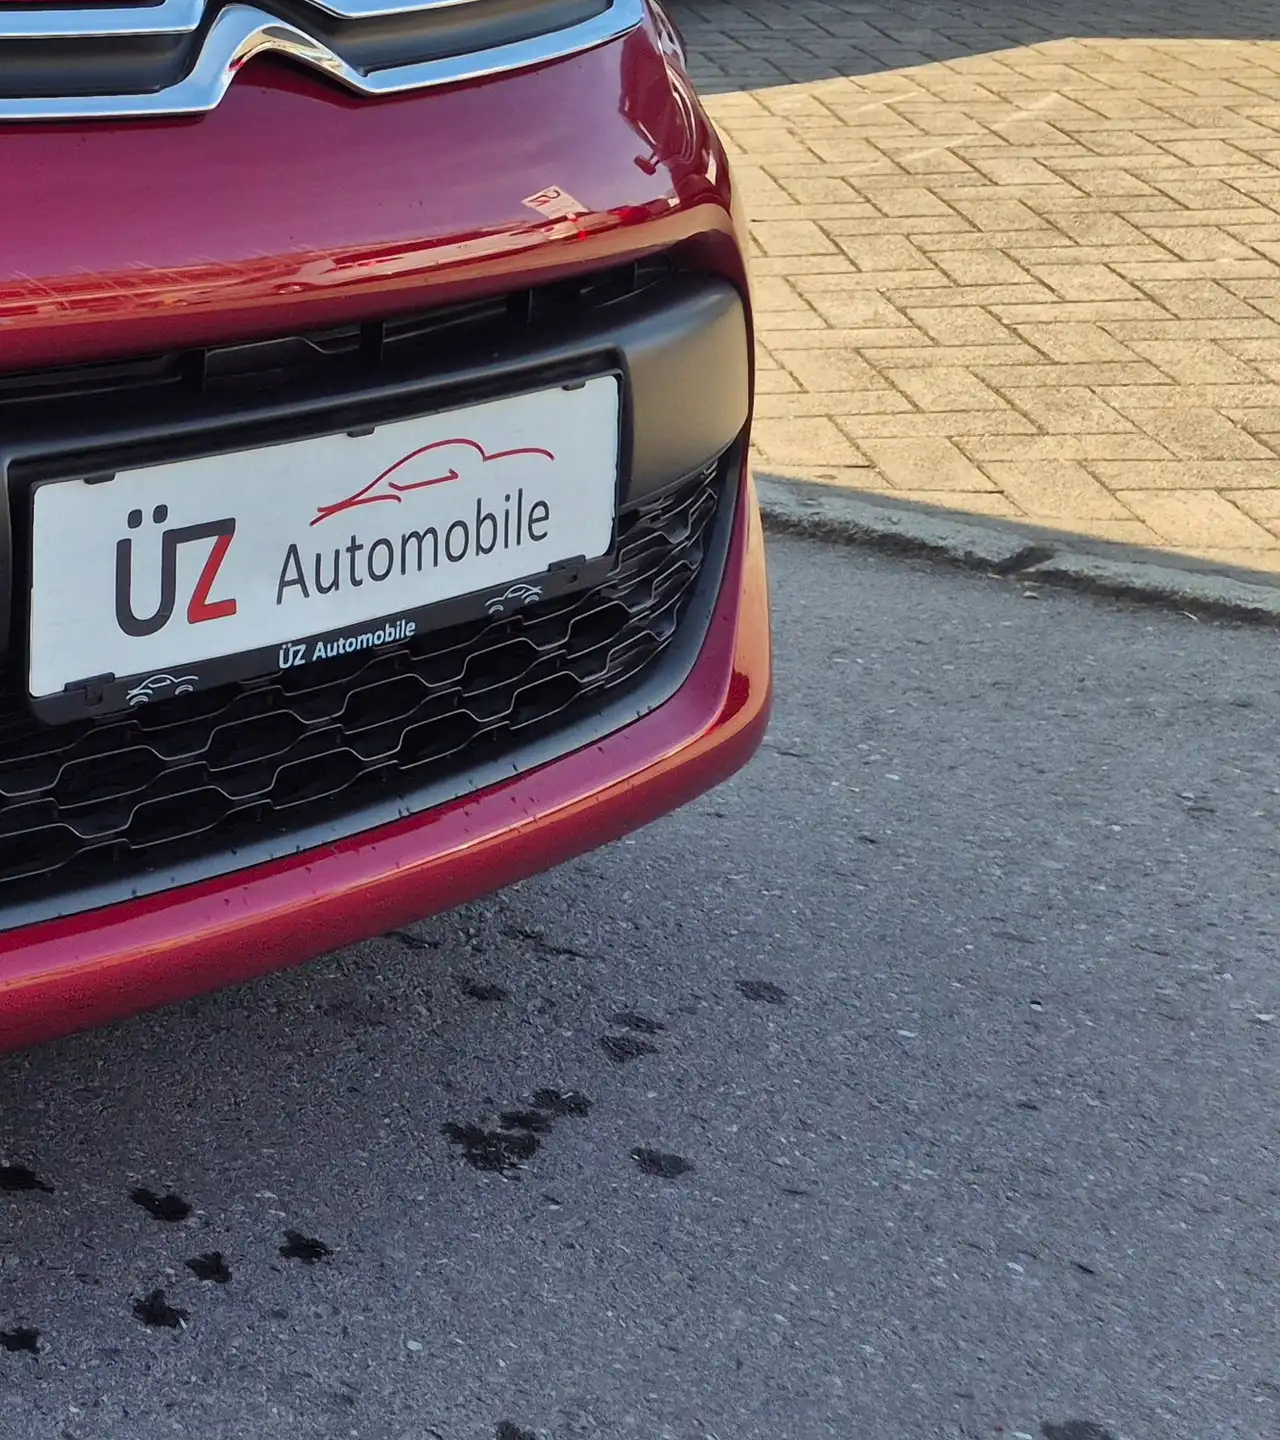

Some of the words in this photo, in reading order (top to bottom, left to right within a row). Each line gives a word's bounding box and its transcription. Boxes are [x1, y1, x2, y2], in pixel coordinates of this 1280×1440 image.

[115, 503, 238, 639] ÜZ
[275, 488, 551, 606] Automobile
[278, 643, 306, 670] ÜZ
[312, 619, 416, 662] Automobile
